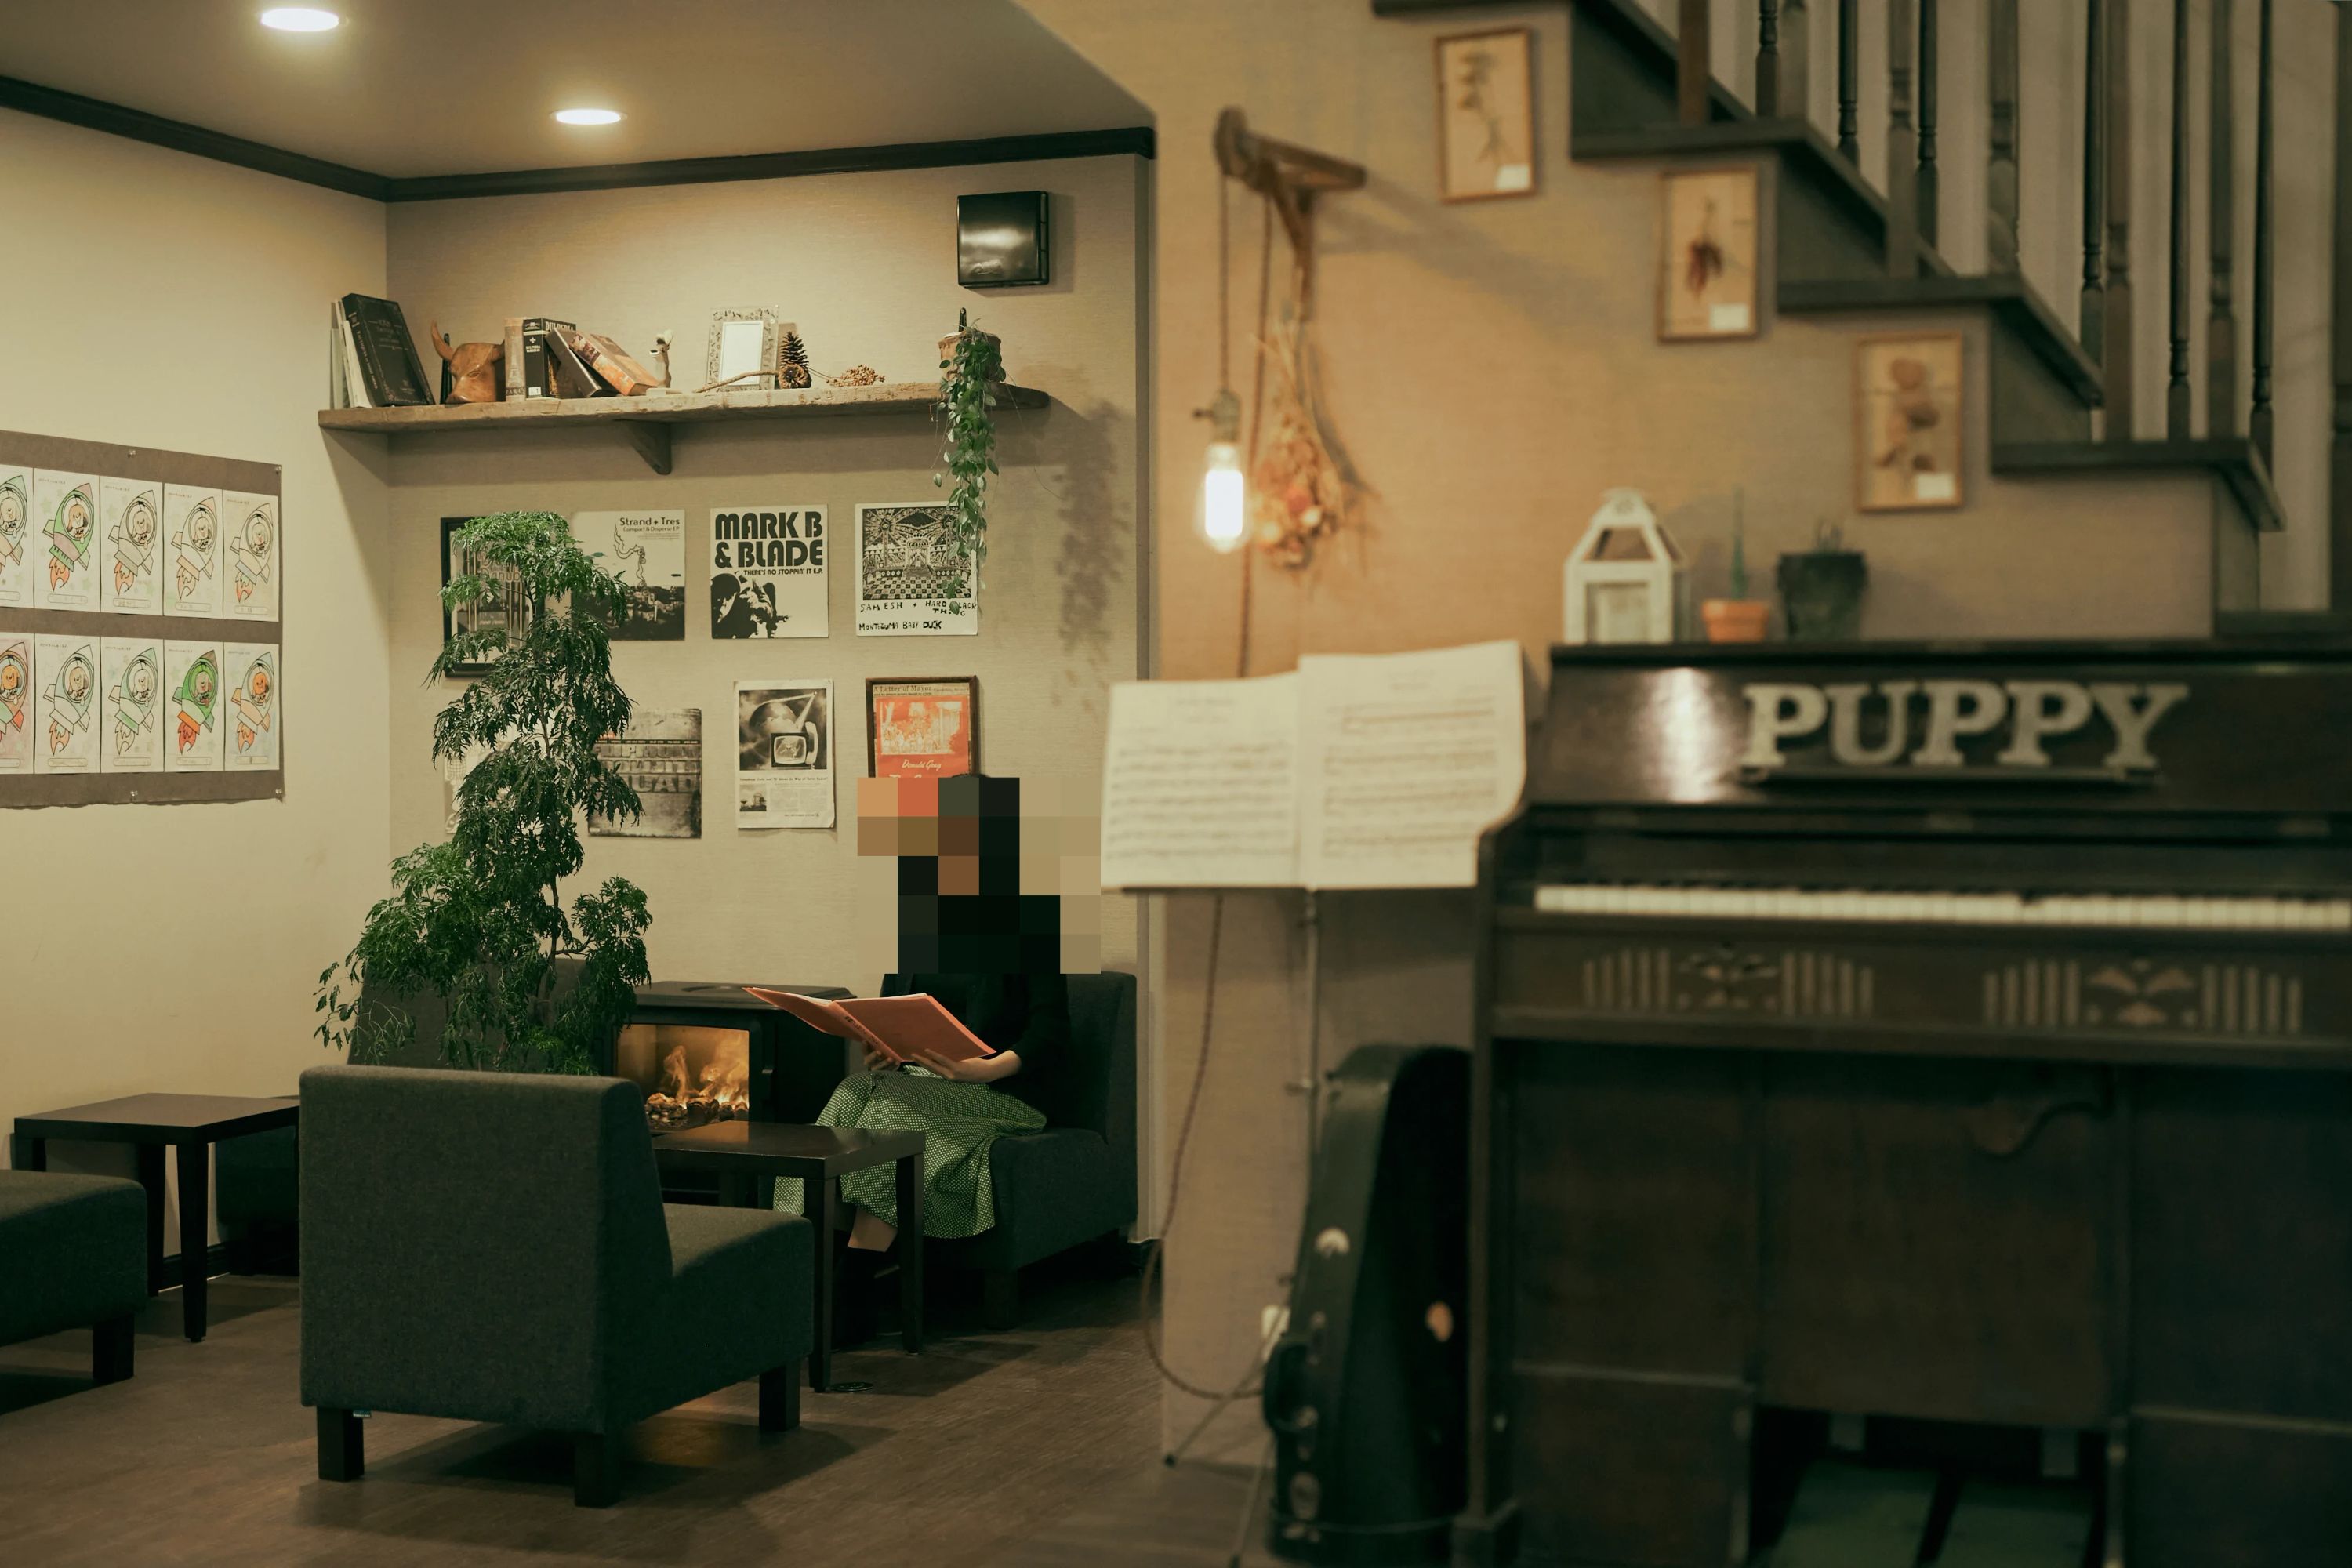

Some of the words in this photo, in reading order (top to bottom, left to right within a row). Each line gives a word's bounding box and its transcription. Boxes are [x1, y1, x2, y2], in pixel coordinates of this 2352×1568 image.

[619, 517, 652, 526] Strand
[661, 517, 681, 525] Tres
[715, 511, 799, 540] MARK
[804, 511, 823, 538] B
[714, 541, 733, 568] &
[738, 539, 823, 568] BLADE
[884, 601, 903, 610] ESH
[910, 684, 931, 693] Mayor
[1739, 679, 2190, 769] PUPPY
